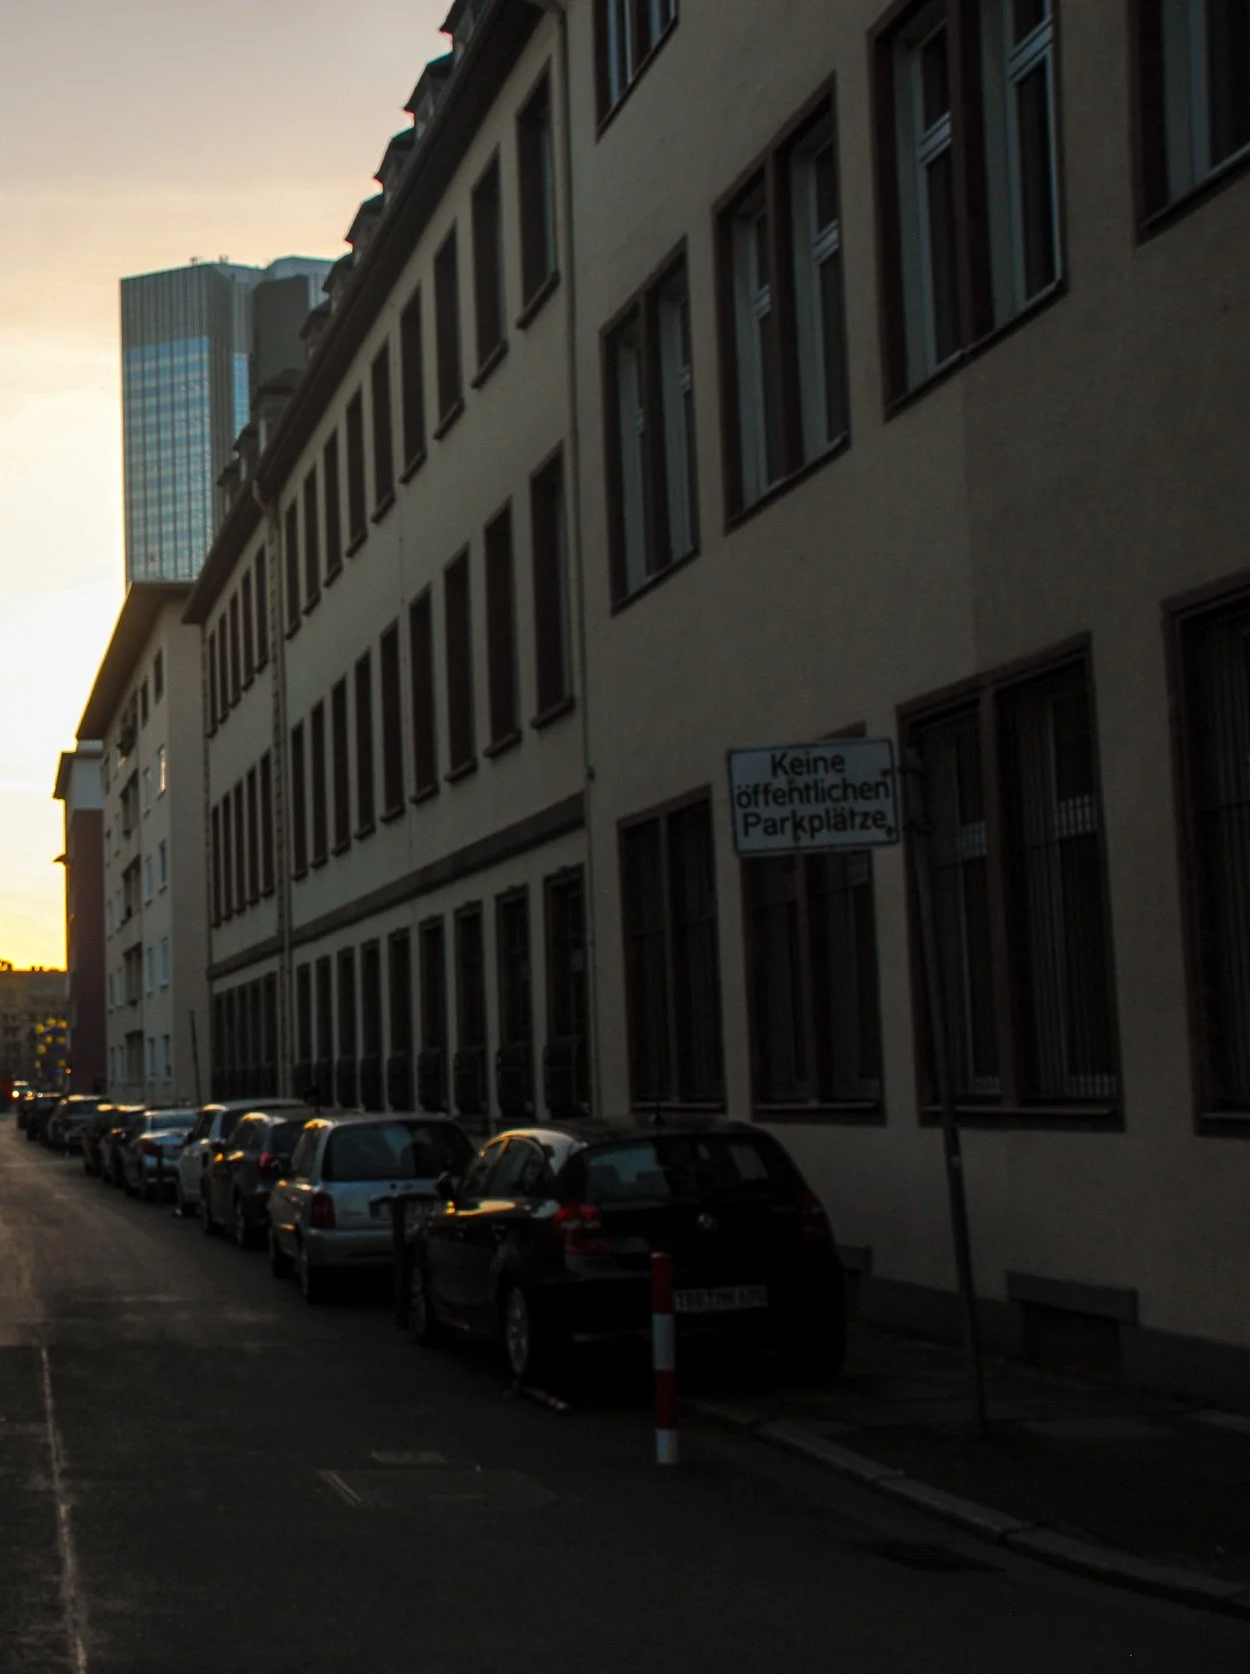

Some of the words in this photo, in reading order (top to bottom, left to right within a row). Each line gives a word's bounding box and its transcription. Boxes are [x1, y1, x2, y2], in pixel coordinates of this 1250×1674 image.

[770, 750, 846, 778] Keine
[735, 776, 890, 810] öffentlichen
[743, 806, 887, 840] Parkplätze
